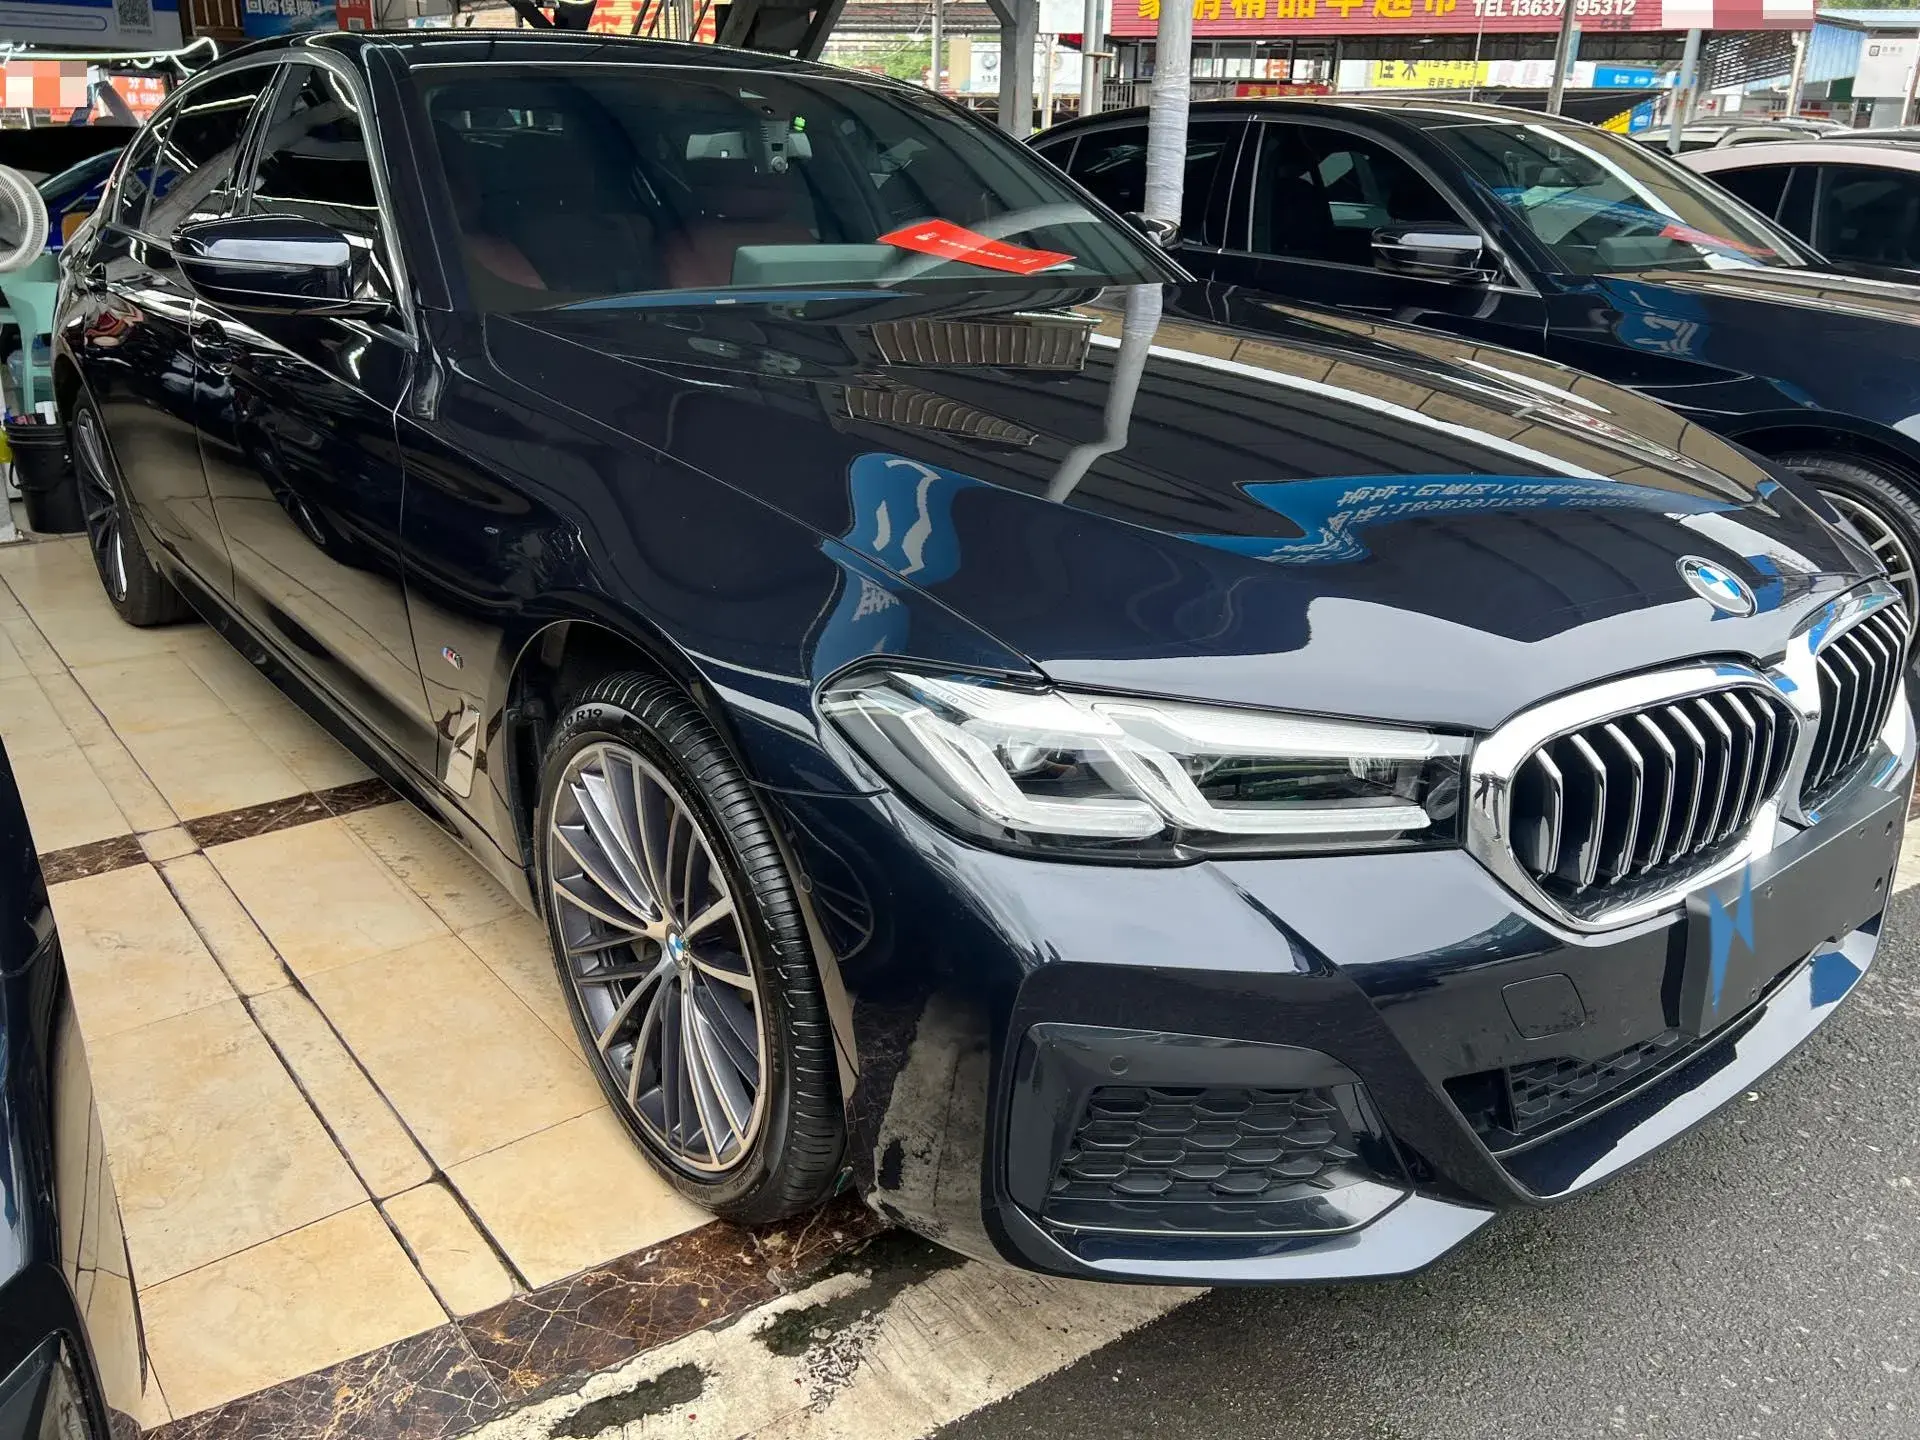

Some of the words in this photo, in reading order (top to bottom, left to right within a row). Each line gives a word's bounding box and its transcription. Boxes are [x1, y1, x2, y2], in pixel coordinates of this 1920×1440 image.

[1473, 0, 1508, 17] TEL
[1511, 0, 1637, 16] 1363795312
[576, 708, 603, 721] R19
